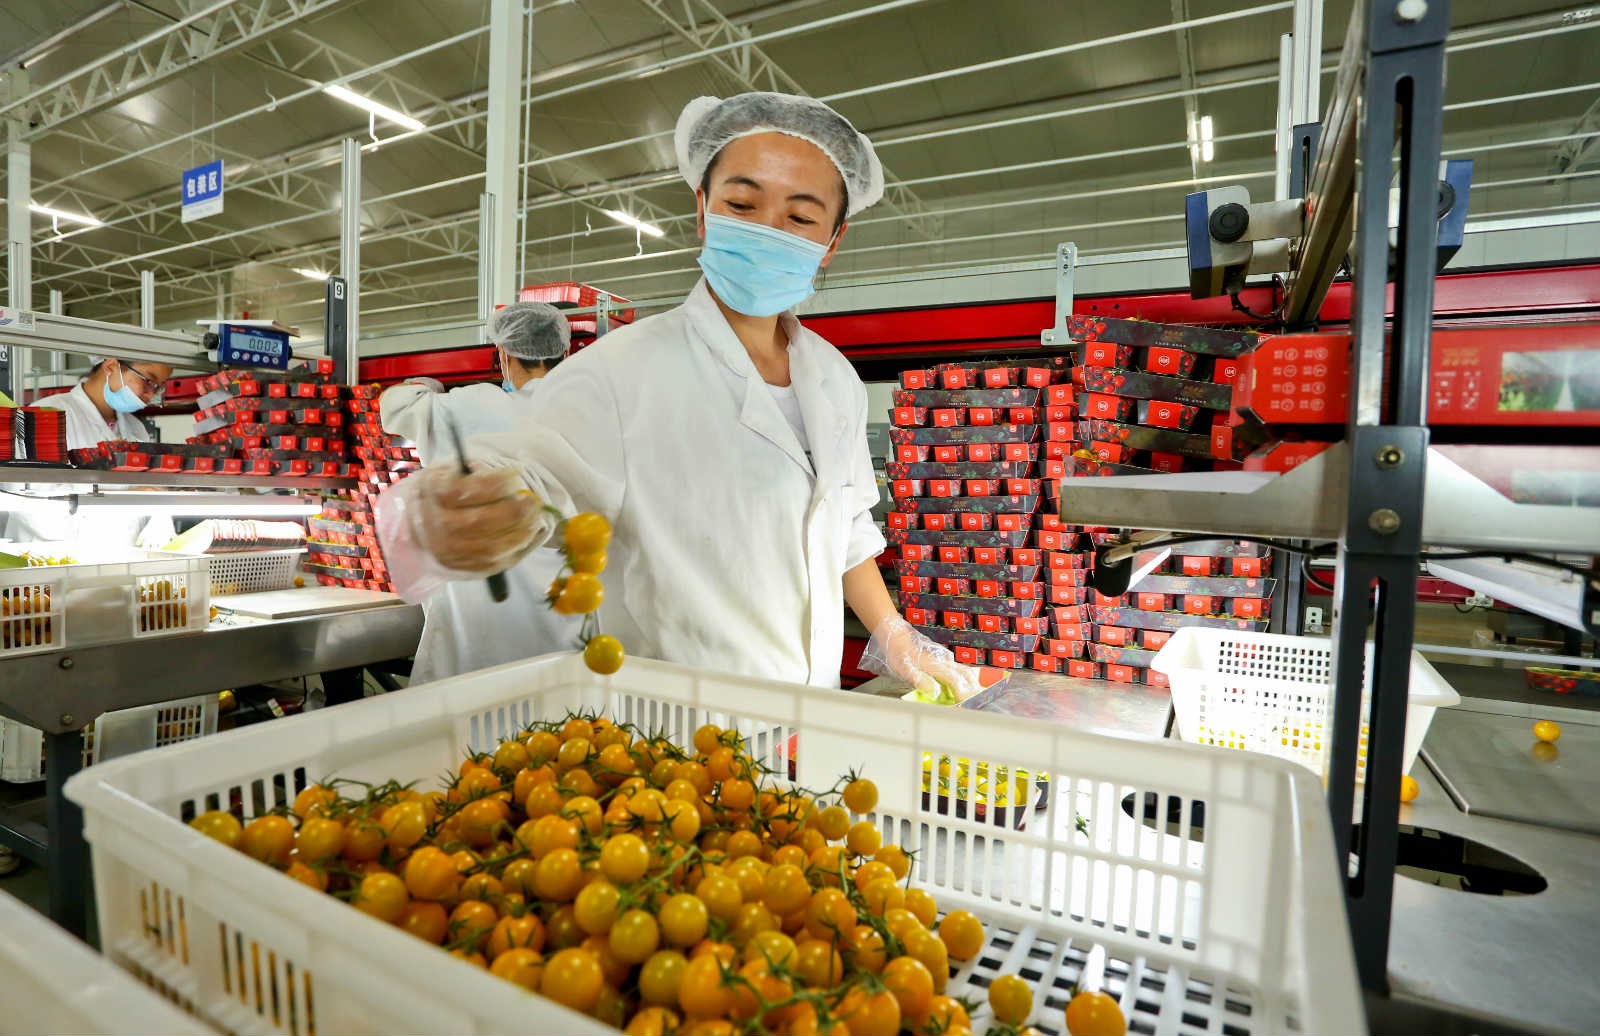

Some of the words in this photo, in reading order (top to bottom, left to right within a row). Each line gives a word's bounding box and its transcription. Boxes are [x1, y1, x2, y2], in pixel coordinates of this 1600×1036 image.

[187, 171, 218, 198] 包装区
[336, 284, 343, 296] 9
